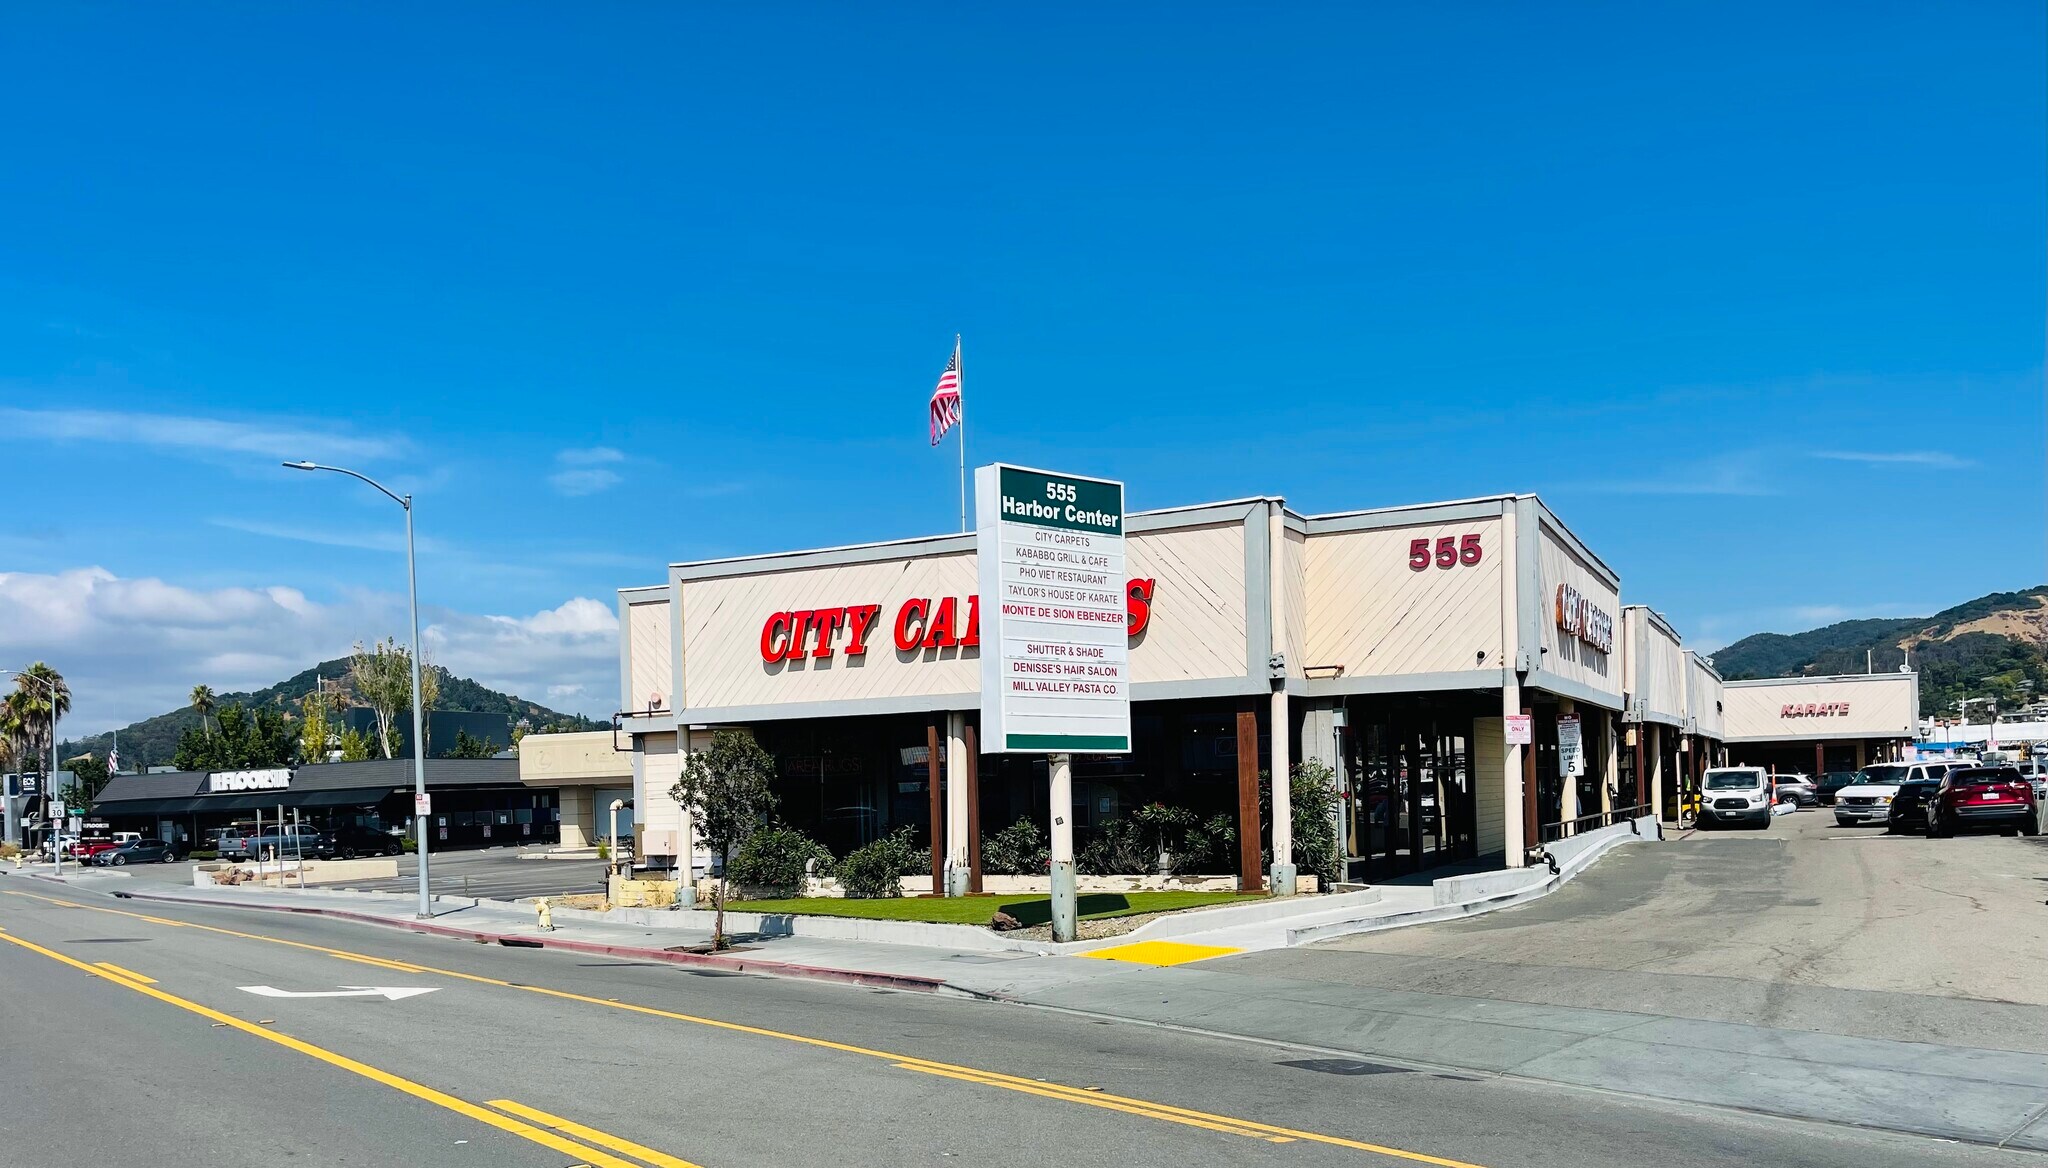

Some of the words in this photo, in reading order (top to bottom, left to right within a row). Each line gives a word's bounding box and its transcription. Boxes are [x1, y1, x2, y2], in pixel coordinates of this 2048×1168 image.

[1046, 481, 1077, 502] 555
[1002, 495, 1061, 520] Harbor
[1064, 504, 1119, 527] Center
[1035, 531, 1053, 542] CITY
[1054, 534, 1090, 547] CARPETS
[1016, 547, 1055, 562] KABABBQ
[1057, 552, 1080, 564] GRILL
[1081, 555, 1087, 565] &
[1088, 556, 1108, 567] CAFE
[1409, 533, 1482, 570] 555
[1020, 567, 1037, 578] PHO
[1038, 569, 1056, 580] VIET
[1057, 571, 1107, 585] RESTAURANT
[1008, 585, 1046, 598] TAYLOR'S
[1048, 588, 1074, 600] HOUSE
[1076, 591, 1086, 601] OF
[1089, 592, 1118, 605] KARATE
[1002, 604, 1036, 617] MONTE
[1038, 607, 1051, 618] DE
[1053, 608, 1075, 619] SION
[1077, 610, 1124, 624] EBENEZER
[760, 603, 881, 664] CITY
[1027, 643, 1066, 656] SHUTTER
[1068, 646, 1075, 657] &
[1076, 647, 1104, 658] SHADE
[1013, 662, 1062, 674] DENISSE'S
[1063, 665, 1086, 675] HAIR
[1087, 666, 1118, 677] SALON
[1012, 681, 1035, 691] MILL
[1035, 682, 1071, 693] VALLEY
[1073, 683, 1101, 694] PASTA
[1103, 684, 1119, 695] CO.
[1780, 702, 1850, 718] KARATE
[788, 759, 820, 773] AREA
[824, 757, 861, 772] RUGS
[1567, 761, 1576, 773] 5
[52, 809, 62, 817] 30
